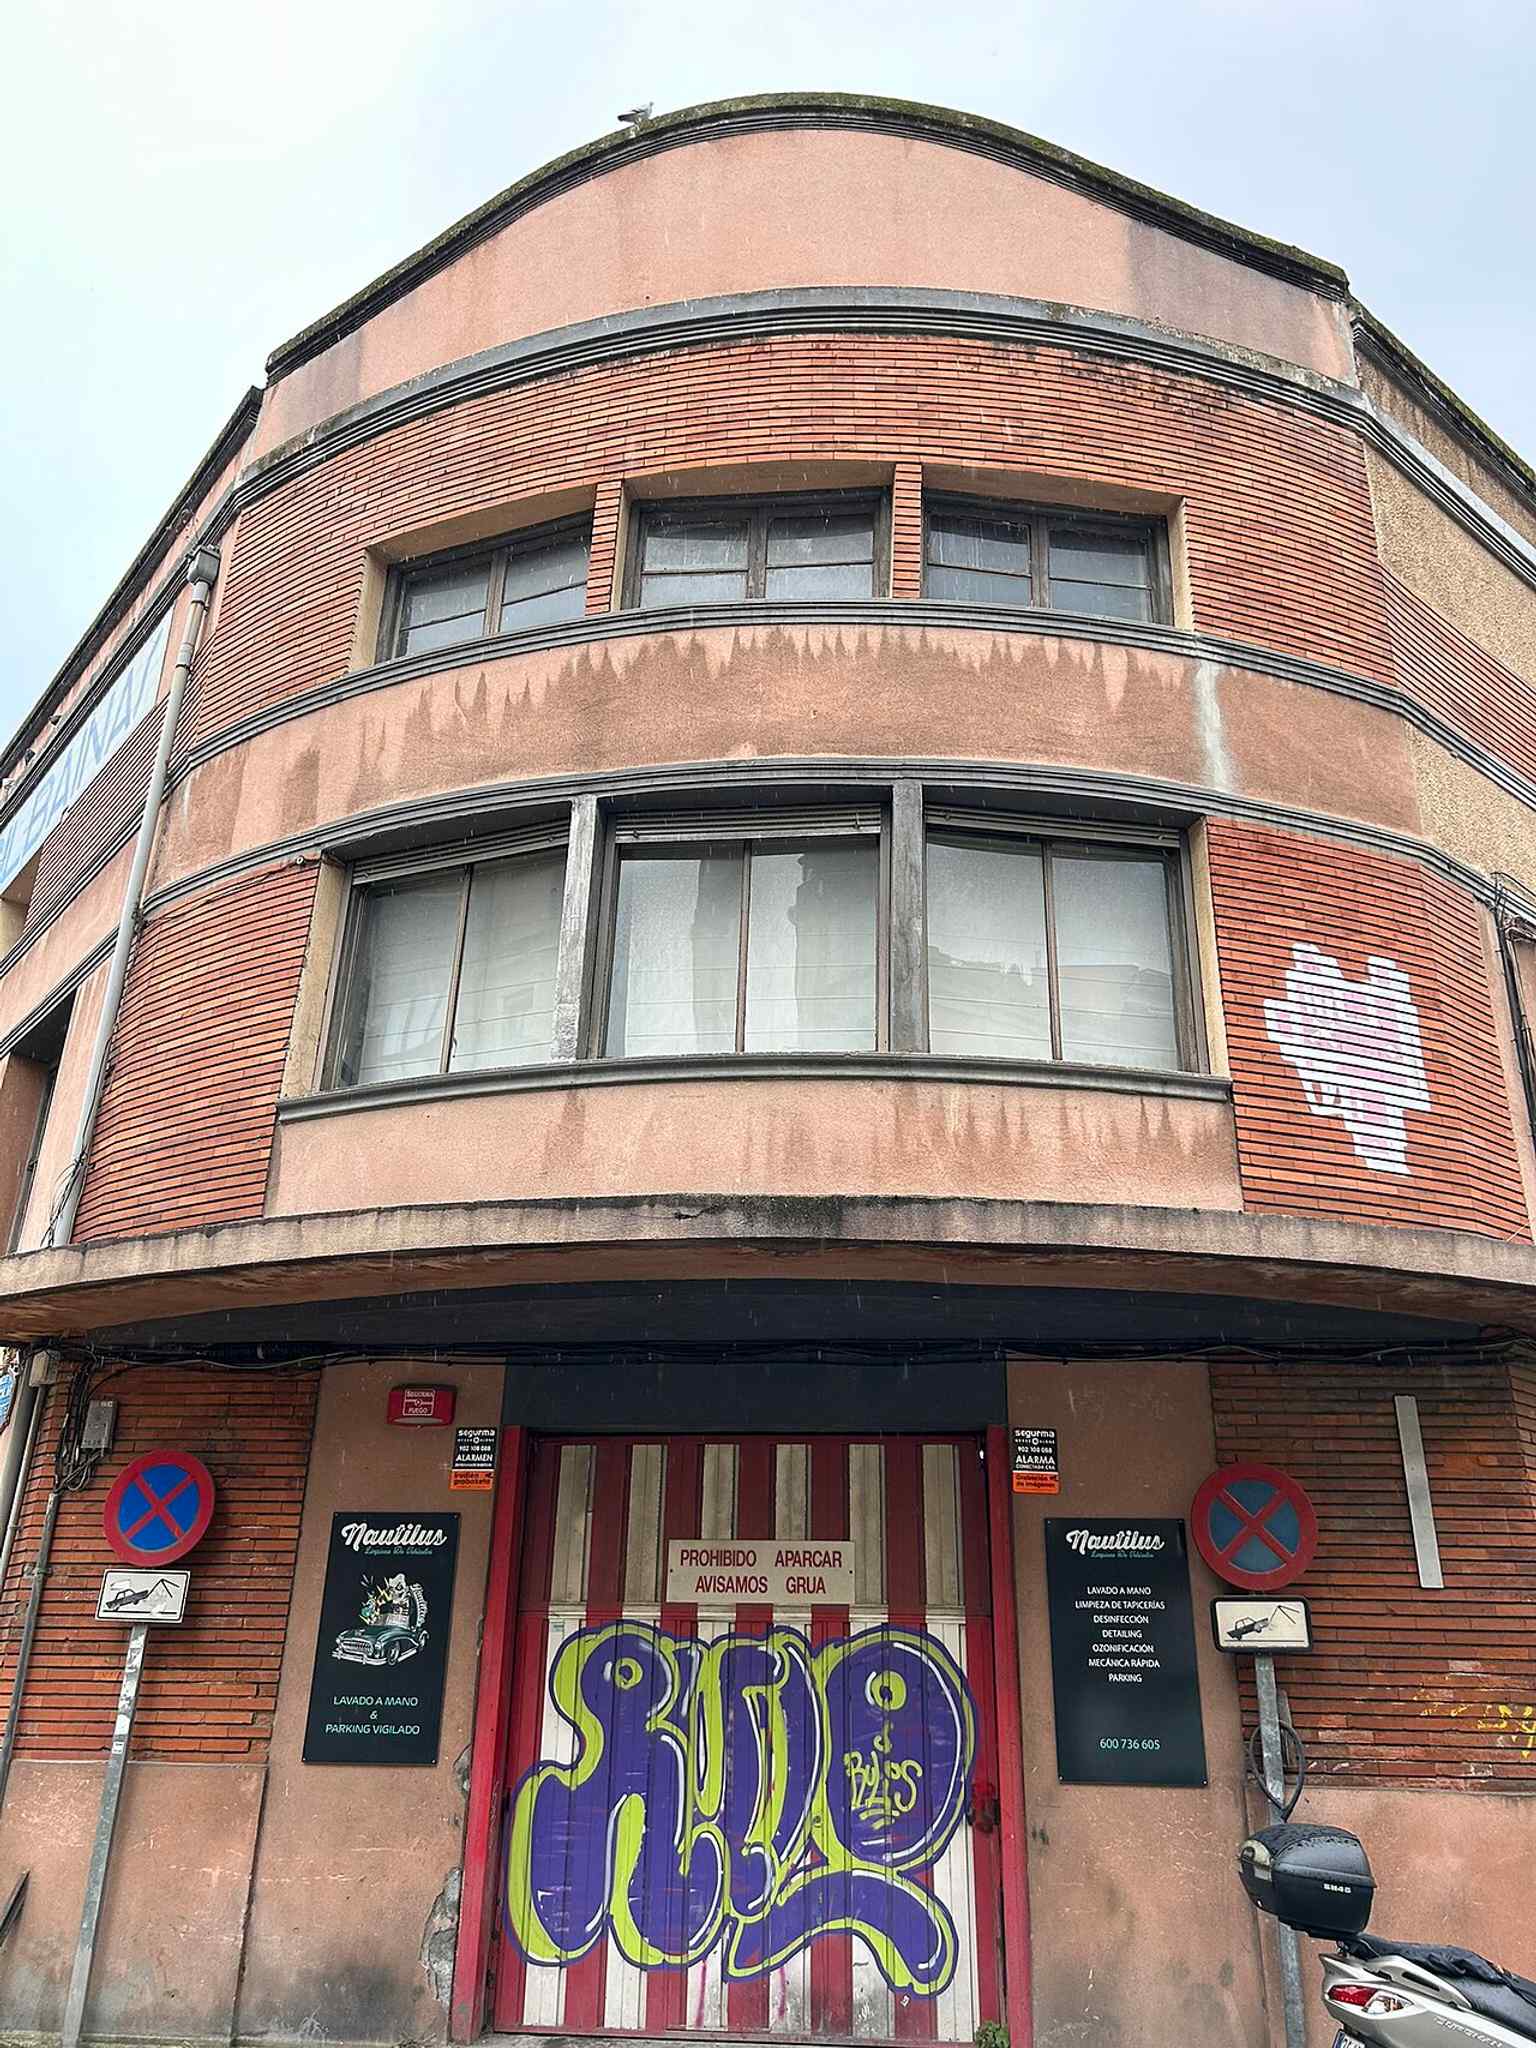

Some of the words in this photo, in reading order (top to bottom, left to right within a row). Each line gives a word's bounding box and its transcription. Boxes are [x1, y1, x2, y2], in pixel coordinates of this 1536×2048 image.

[457, 1429, 496, 1438] segurma
[1014, 1429, 1056, 1439] segurma
[1015, 1454, 1056, 1465] ALARMA
[341, 1522, 448, 1551] Nautilus
[1065, 1529, 1165, 1555] Nautilus
[680, 1549, 757, 1567] PROHIBIDO
[775, 1550, 842, 1568] APARCAR
[695, 1575, 768, 1593] AVISAMOS
[785, 1576, 826, 1594] GRUA
[1087, 1586, 1118, 1595] LAVADO
[1119, 1587, 1125, 1595] A
[1126, 1587, 1151, 1595] MANO
[1075, 1600, 1110, 1609] LIMPIEZA
[1111, 1601, 1122, 1609] DE
[1102, 1629, 1142, 1638] DETAILING
[1108, 1673, 1143, 1682] PARKING
[333, 1696, 374, 1706] LAVADO
[374, 1697, 383, 1706] A
[384, 1697, 418, 1707] MANO
[369, 1710, 378, 1719] &
[325, 1724, 370, 1734] PARKING
[372, 1725, 420, 1735] VIGILADO
[1100, 1738, 1119, 1749] 600
[1121, 1739, 1140, 1750] 736
[1141, 1739, 1161, 1750] 605
